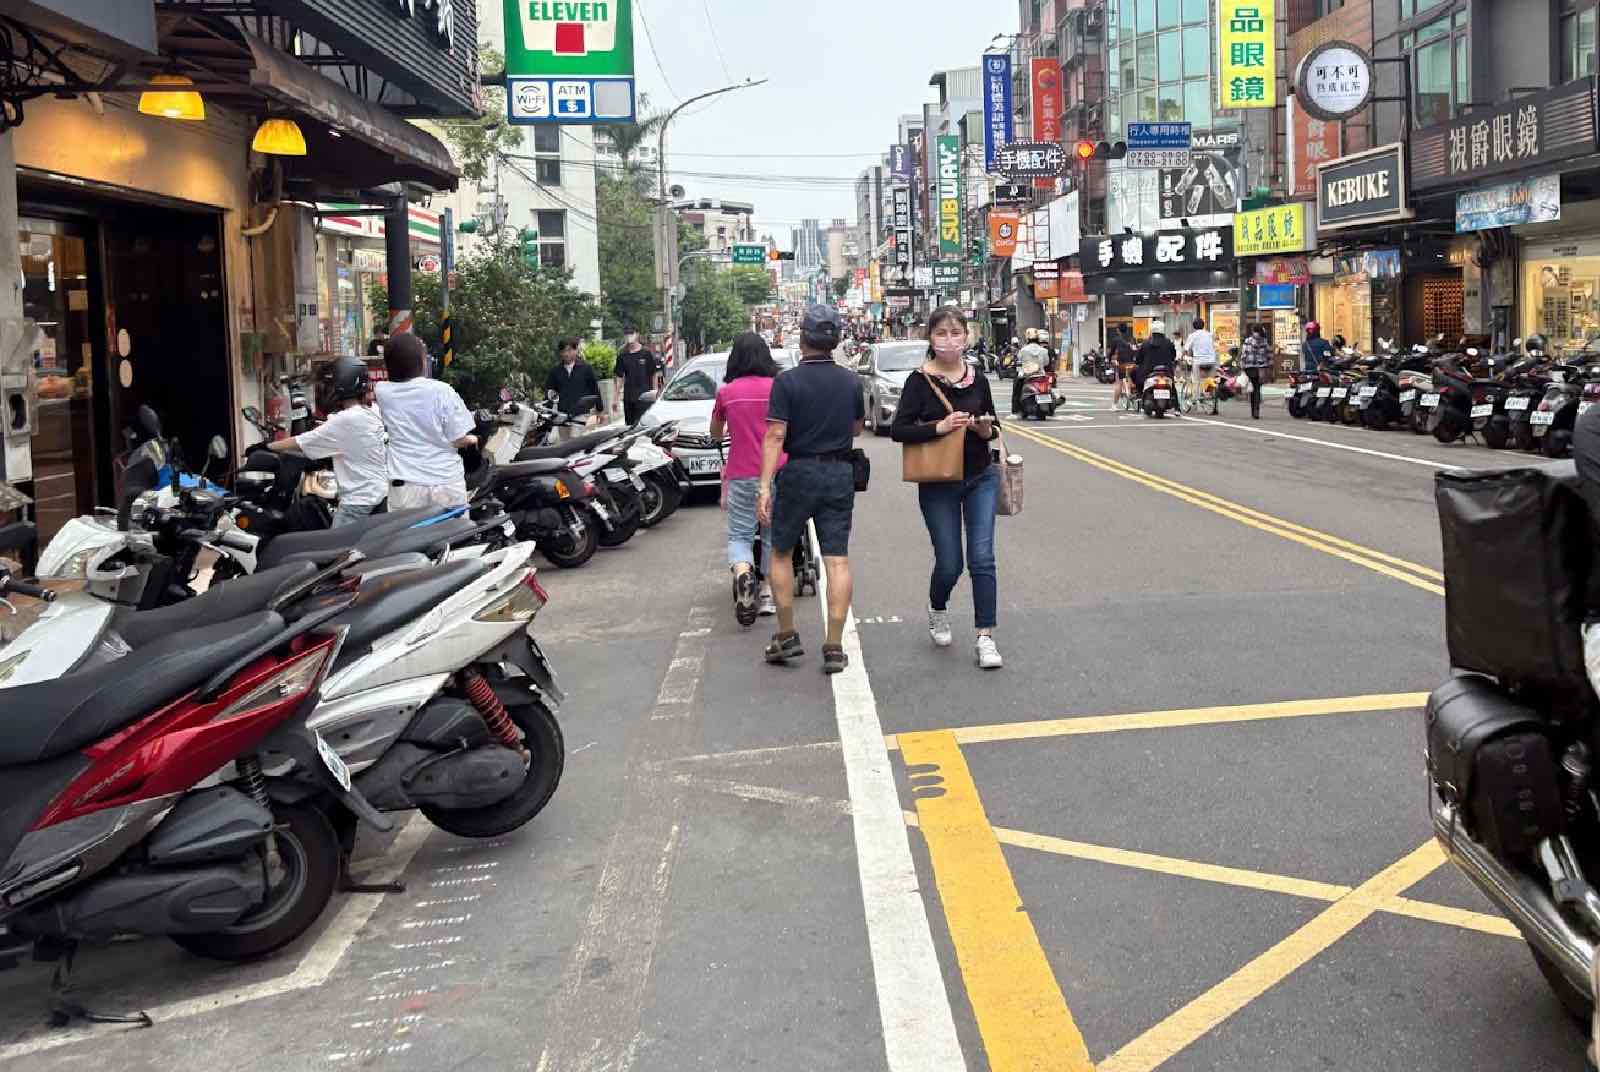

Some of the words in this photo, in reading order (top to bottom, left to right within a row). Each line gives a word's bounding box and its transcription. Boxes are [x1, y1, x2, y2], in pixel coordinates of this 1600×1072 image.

[1230, 8, 1265, 101] 品眼鏡
[1315, 65, 1360, 80] 可不可
[558, 86, 586, 95] ATM
[1001, 147, 1061, 170] 手機配件
[1449, 104, 1539, 177] 視爵眼鏡
[940, 143, 960, 245] SUBWAY
[1327, 169, 1390, 208] KEBUKE
[1098, 231, 1225, 268] 手機配件
